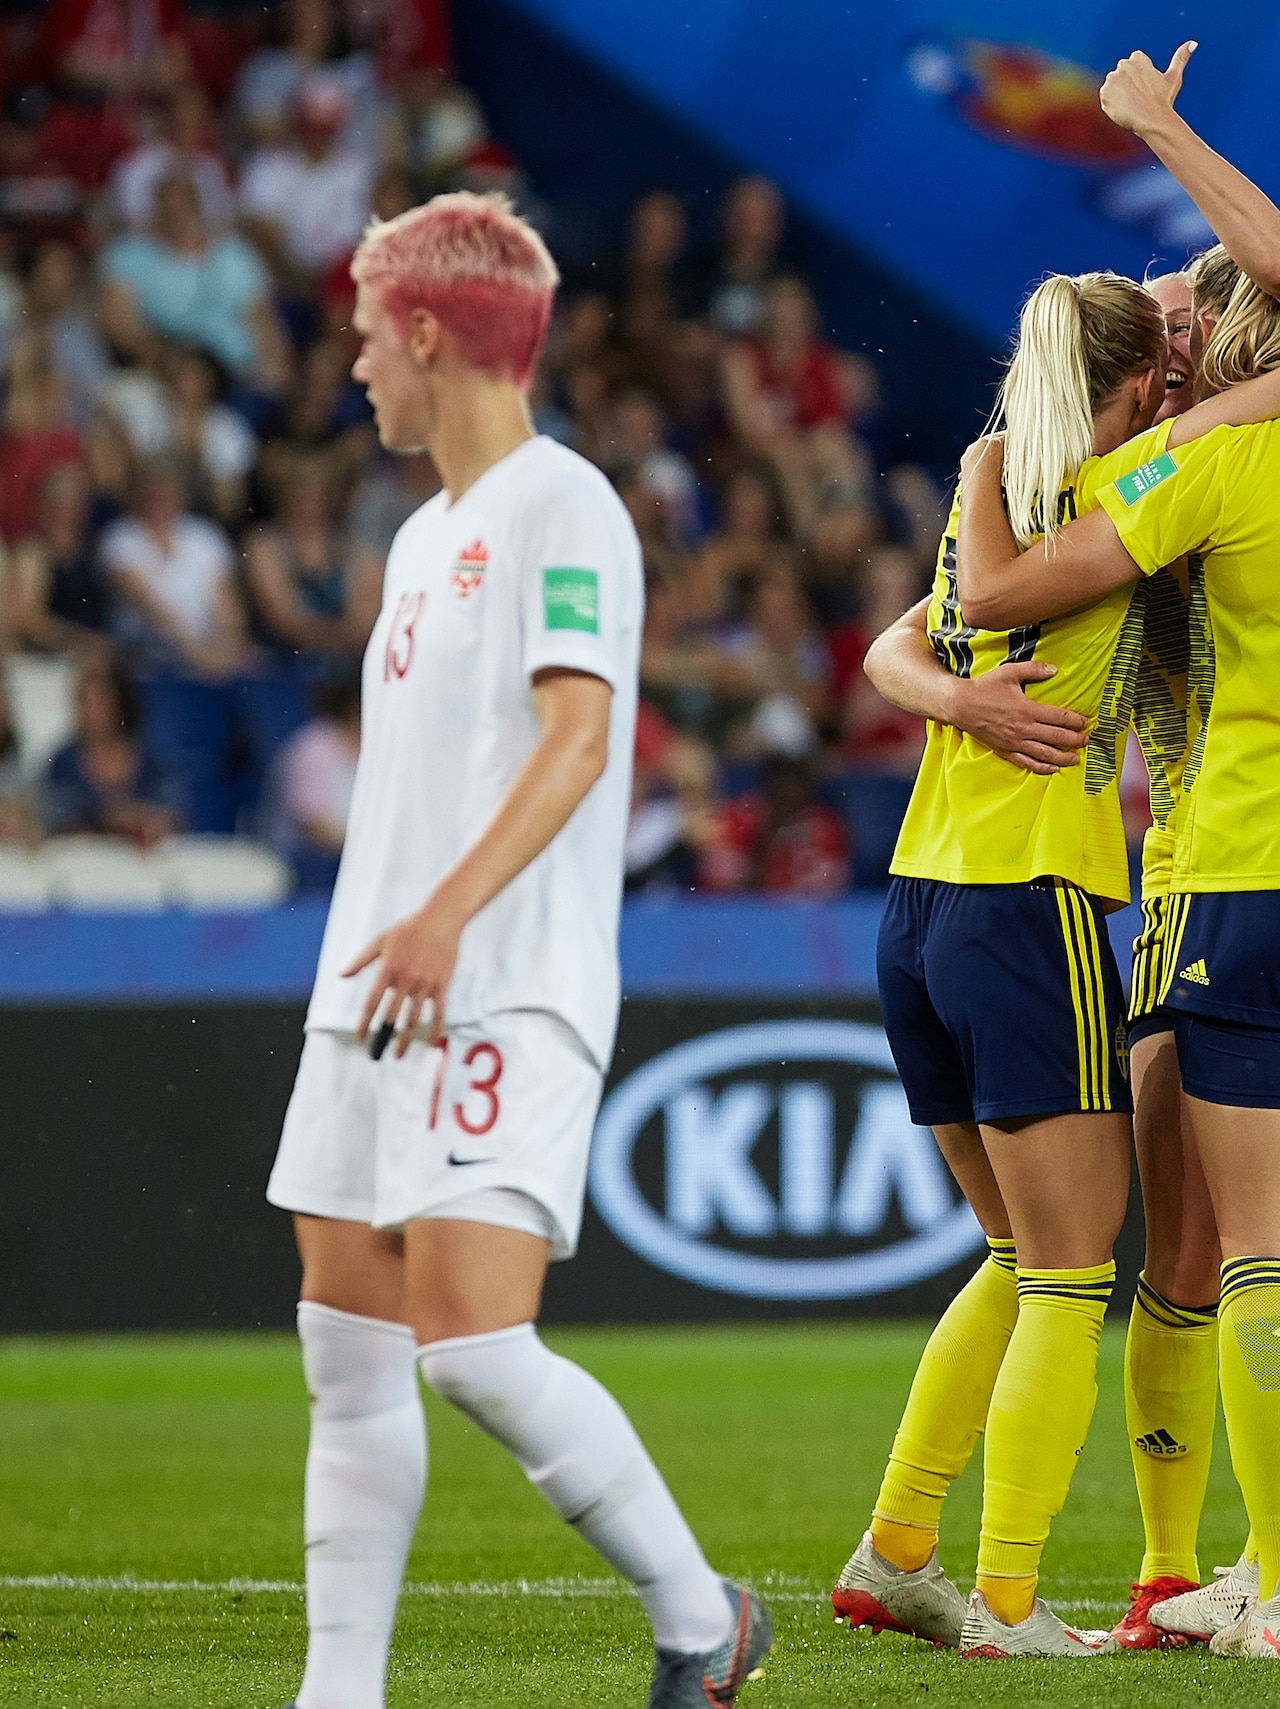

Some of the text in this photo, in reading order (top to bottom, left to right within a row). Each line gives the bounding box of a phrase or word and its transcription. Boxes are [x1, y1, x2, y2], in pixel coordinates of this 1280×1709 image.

[1131, 475, 1146, 493] FIFA
[384, 591, 428, 682] 13
[1179, 970, 1211, 986] adidas
[428, 1036, 504, 1136] 13
[664, 1080, 956, 1238] KIA
[1134, 1440, 1188, 1455] adidas
